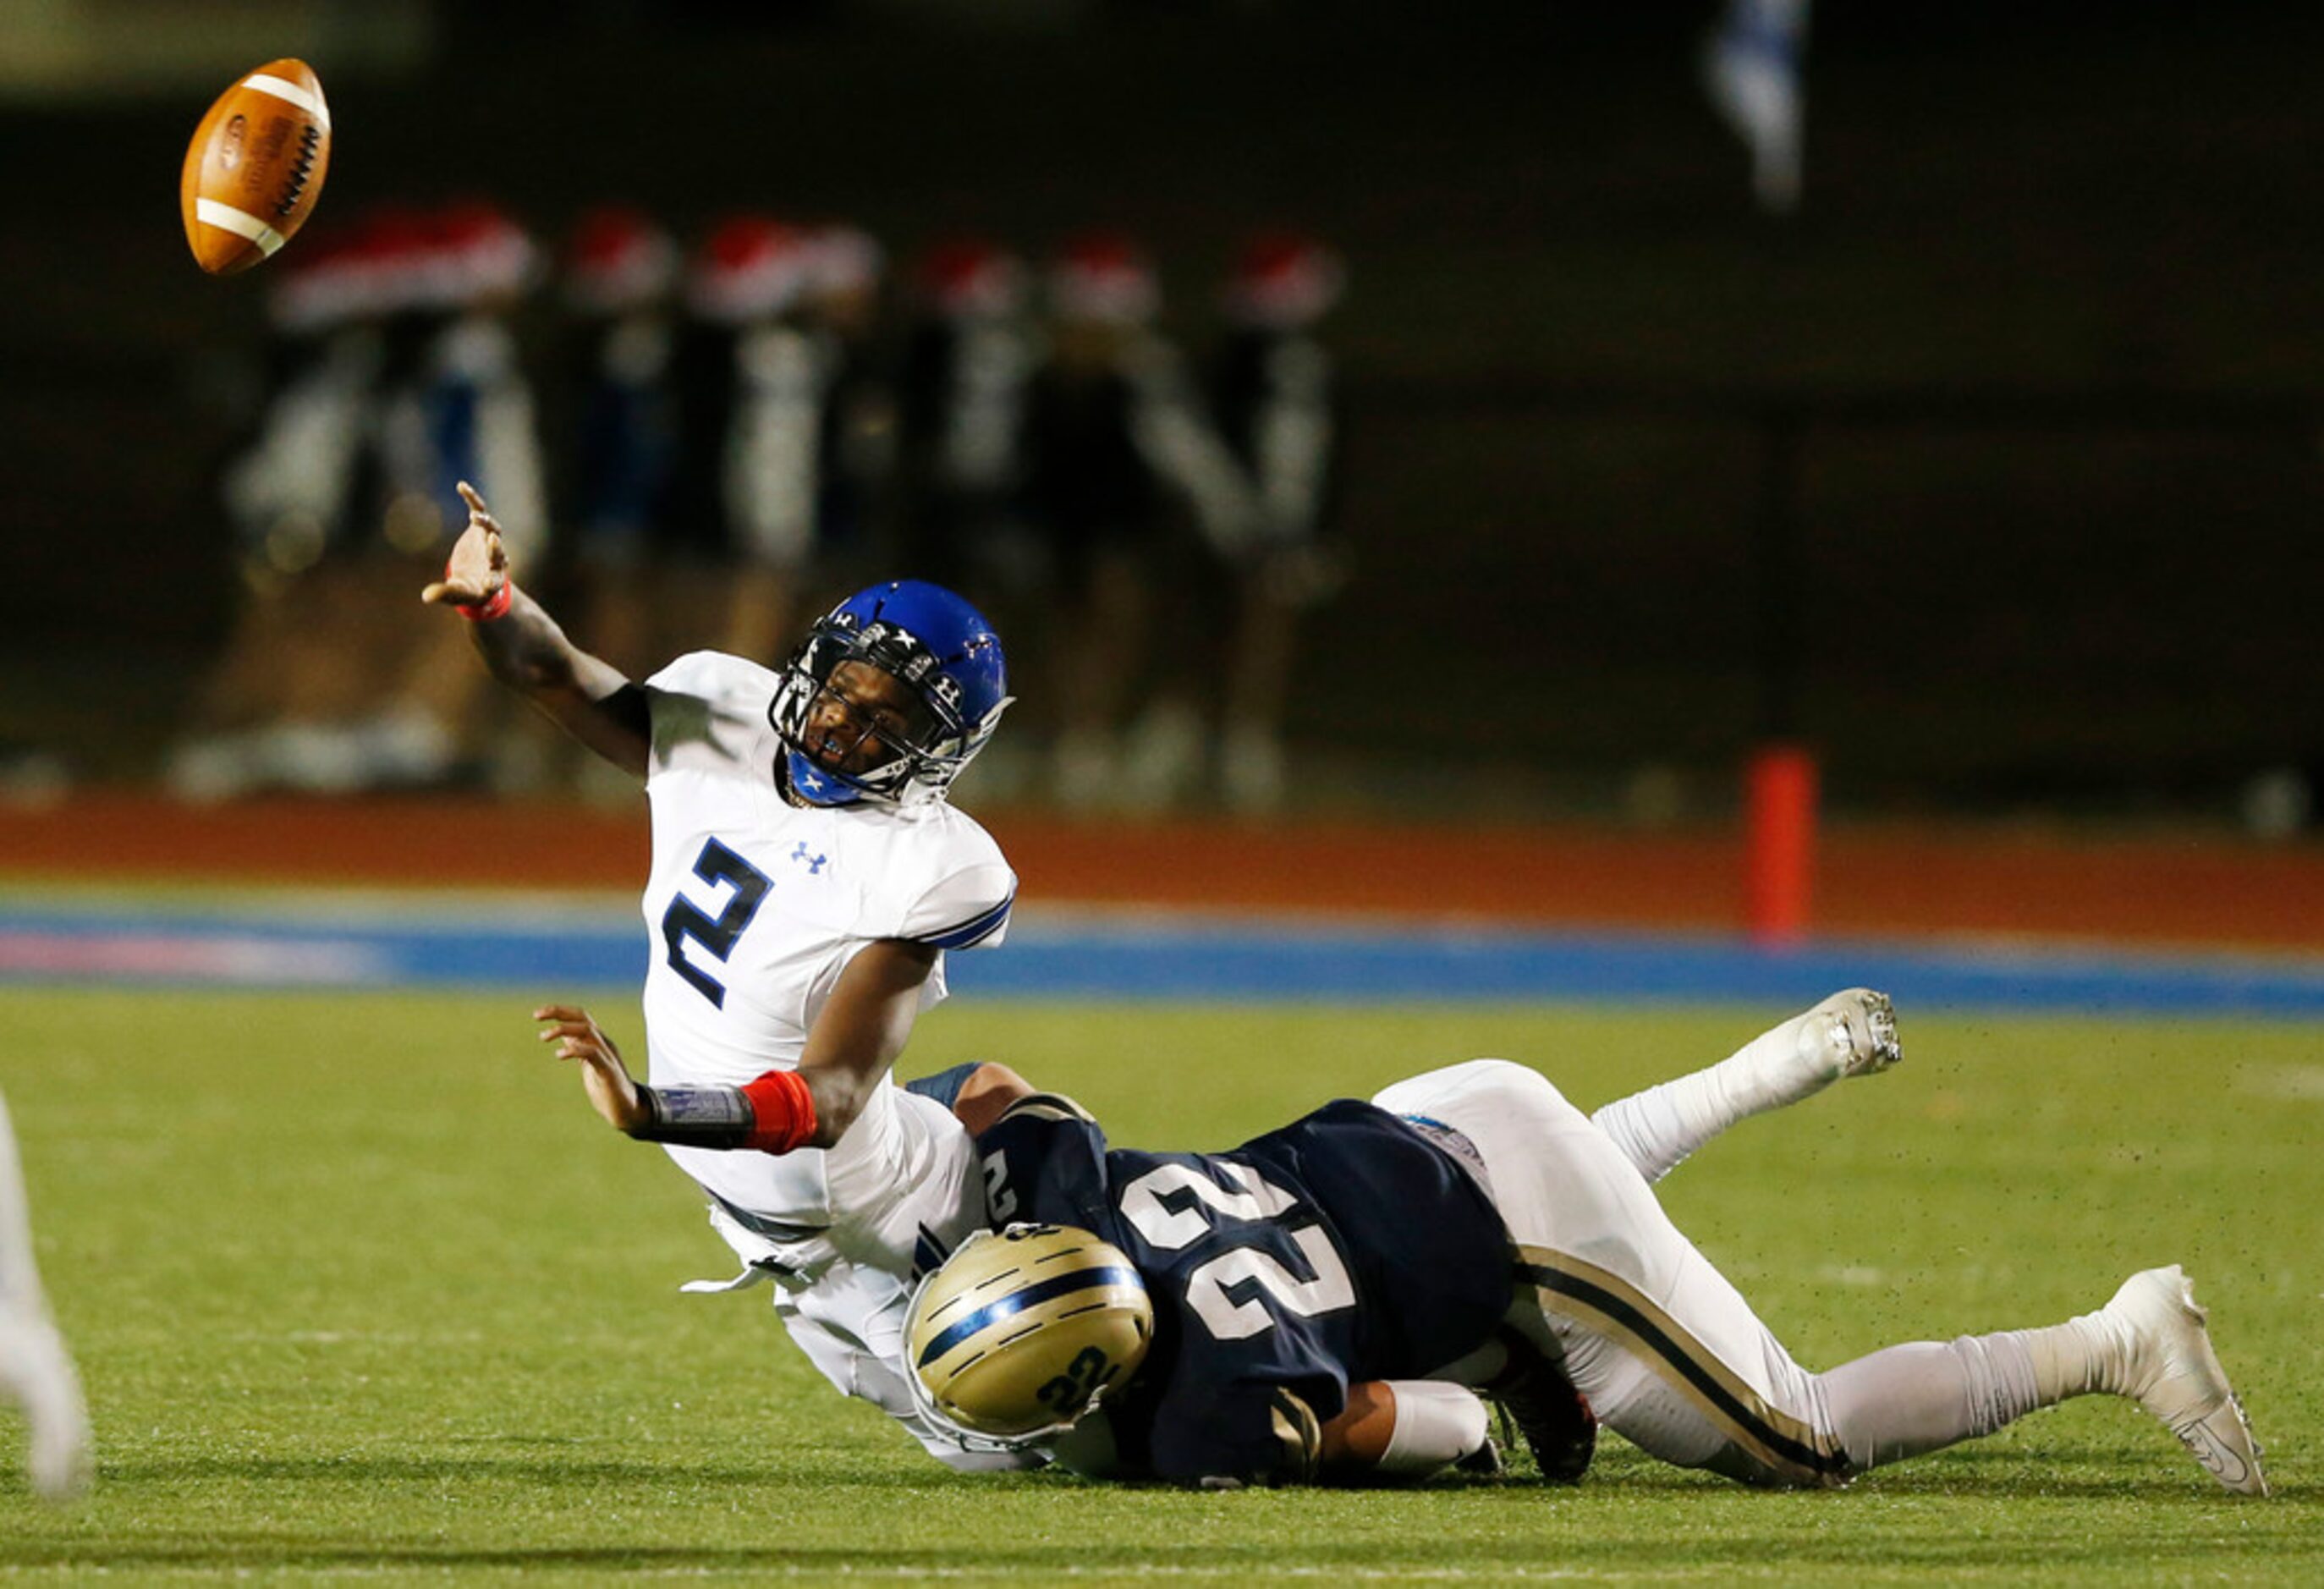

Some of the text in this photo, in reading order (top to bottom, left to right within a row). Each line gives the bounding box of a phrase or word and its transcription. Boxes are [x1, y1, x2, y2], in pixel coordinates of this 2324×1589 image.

[662, 835, 776, 1011] 2
[1119, 1162, 1356, 1340] 22
[1036, 1344, 1121, 1417] 22
